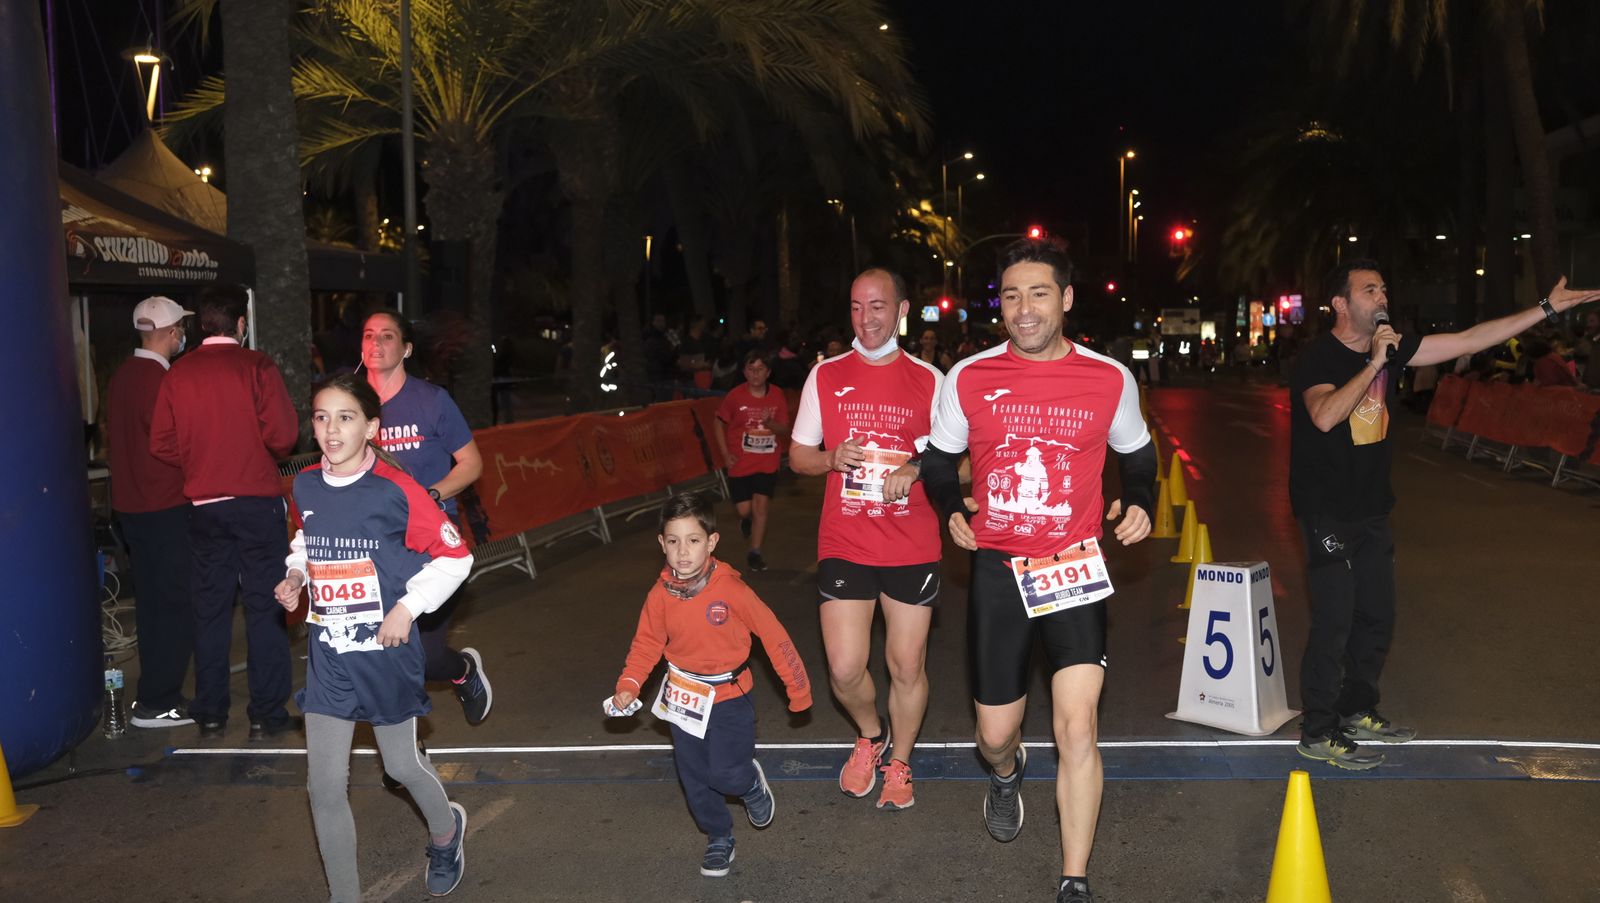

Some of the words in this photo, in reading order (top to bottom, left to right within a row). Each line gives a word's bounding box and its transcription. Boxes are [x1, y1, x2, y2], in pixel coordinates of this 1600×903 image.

[843, 403, 873, 411] CARRERA
[879, 404, 913, 417] BOMBEROS
[1000, 404, 1040, 414] CARRERA
[1047, 406, 1094, 421] BOMBEROS
[880, 414, 905, 425] CIUDAD
[1049, 418, 1083, 430] CIUDAD
[380, 424, 421, 452] BEROS
[856, 465, 891, 481] 314
[335, 537, 380, 550] BOMBEROS
[337, 550, 370, 560] CIUDAD
[1036, 563, 1092, 592] 3191
[1197, 569, 1244, 584] MONDO
[1250, 566, 1269, 584] MONDO
[312, 582, 367, 603] 3048
[1070, 586, 1084, 596] TEAM
[326, 606, 347, 615] CARMEN
[1203, 610, 1234, 680] 5
[1258, 606, 1275, 677] 5
[665, 686, 700, 708] 3191
